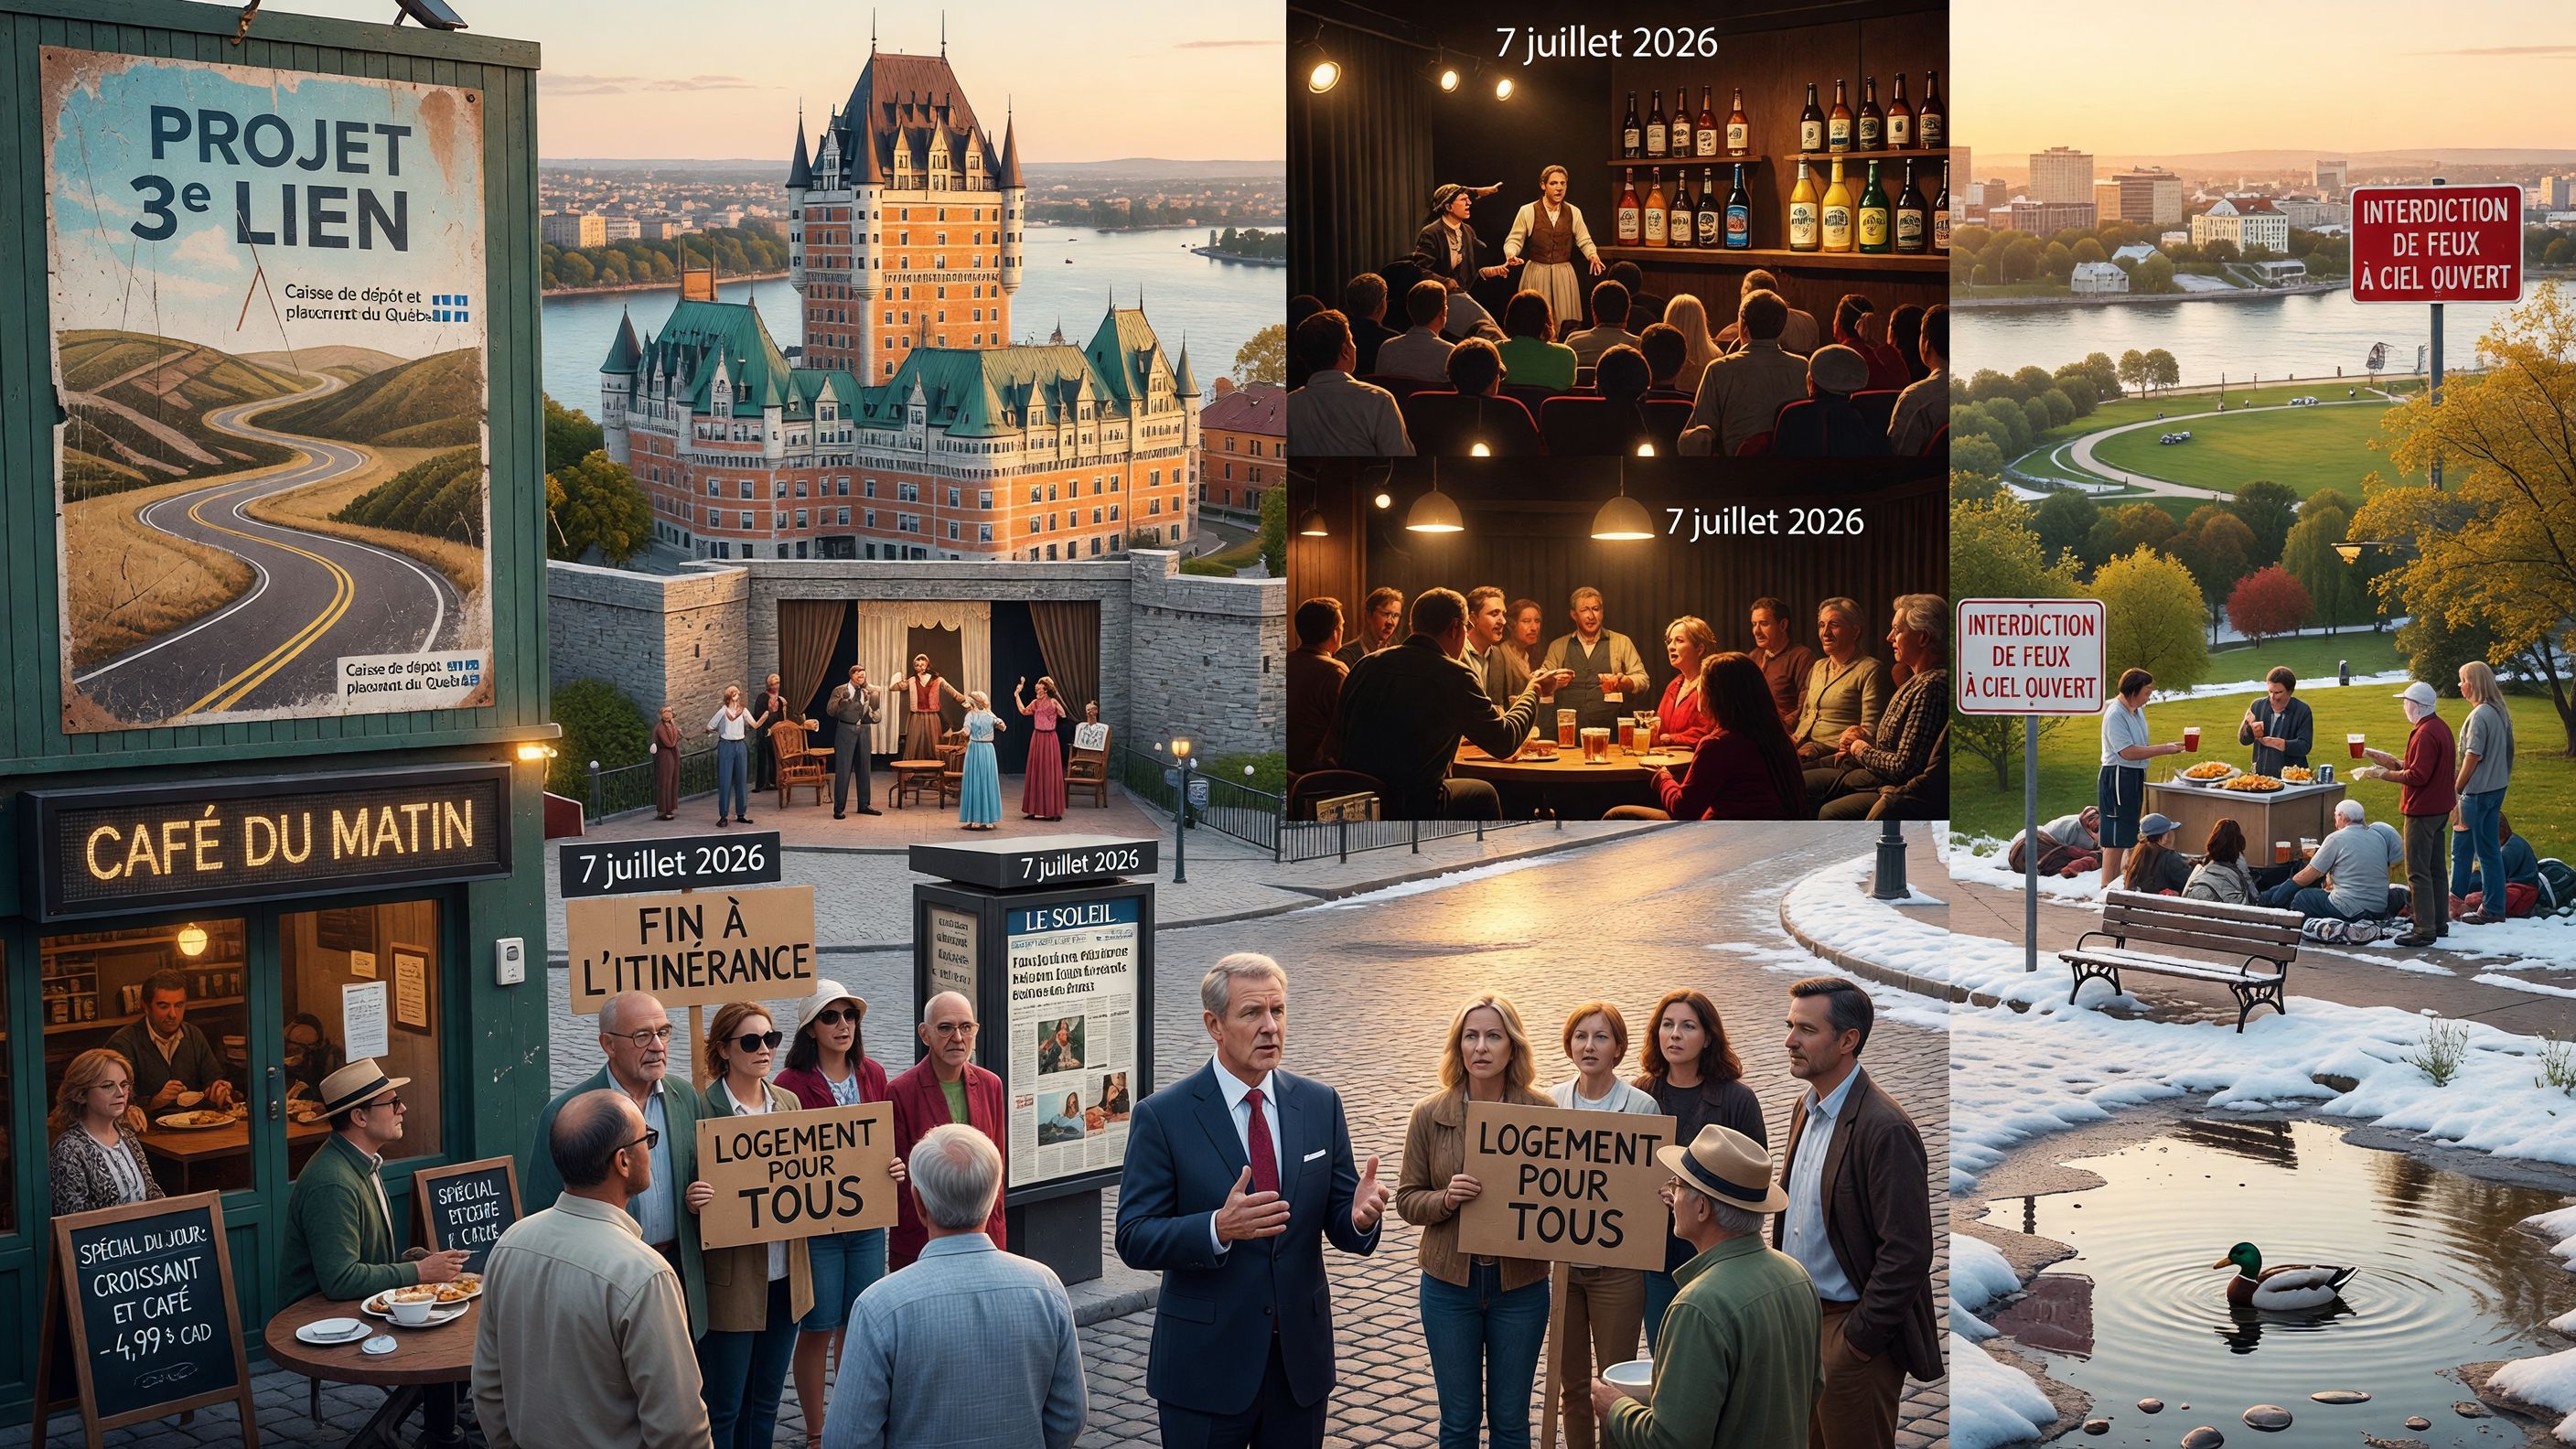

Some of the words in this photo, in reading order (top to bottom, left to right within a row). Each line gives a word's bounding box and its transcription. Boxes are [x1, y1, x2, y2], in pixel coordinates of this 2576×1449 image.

[150, 104, 412, 177] PROJET
[236, 180, 409, 252] LIEN
[2363, 198, 2509, 224] INTERDICTION
[2393, 232, 2420, 257] DE
[2427, 231, 2481, 257] FEUX
[2360, 261, 2375, 291] À
[2380, 266, 2424, 291] CIEL
[2431, 263, 2512, 290] OUVERT
[284, 284, 333, 300] Caisse
[338, 286, 357, 301] de
[360, 286, 402, 305] dépôt
[406, 290, 422, 304] et
[361, 306, 381, 321] du
[1969, 614, 2095, 636] INTERDICTION
[388, 661, 403, 674] de
[1992, 644, 2016, 667] DE
[2023, 644, 2070, 667] FEUX
[405, 679, 422, 690] du
[1965, 671, 1977, 697] À
[1982, 677, 2021, 698] CIEL
[2025, 677, 2098, 698] OUVERT
[85, 804, 222, 882] CAFÉ
[244, 811, 311, 866] DU
[331, 800, 474, 858] MATIN
[579, 854, 596, 885] 7
[602, 846, 687, 889] juillet
[695, 843, 765, 875] 2026
[1021, 857, 1033, 878] 7
[1036, 853, 1089, 883] juillet
[1094, 849, 1139, 872] 2026
[639, 904, 704, 945] FIN
[723, 896, 747, 939] À
[1025, 909, 1047, 931] LE
[1052, 904, 1116, 928] SOLEIL
[584, 940, 810, 996] L'ITINÉRANCE
[714, 1118, 877, 1165] LOGEMENT
[1478, 1122, 1662, 1168] LOGEMENT
[767, 1154, 836, 1183] POUR
[1519, 1164, 1608, 1203] POUR
[438, 1179, 500, 1205] SPÉCIAL
[738, 1175, 864, 1229] TOUS
[1508, 1202, 1625, 1249] TOUS
[80, 1237, 142, 1265] SPÉCIAL
[144, 1232, 163, 1252] DU
[93, 1256, 201, 1298] CROISSANT
[113, 1302, 136, 1325] ET
[143, 1284, 192, 1319] CAFÉ
[180, 1323, 211, 1345] CAD
